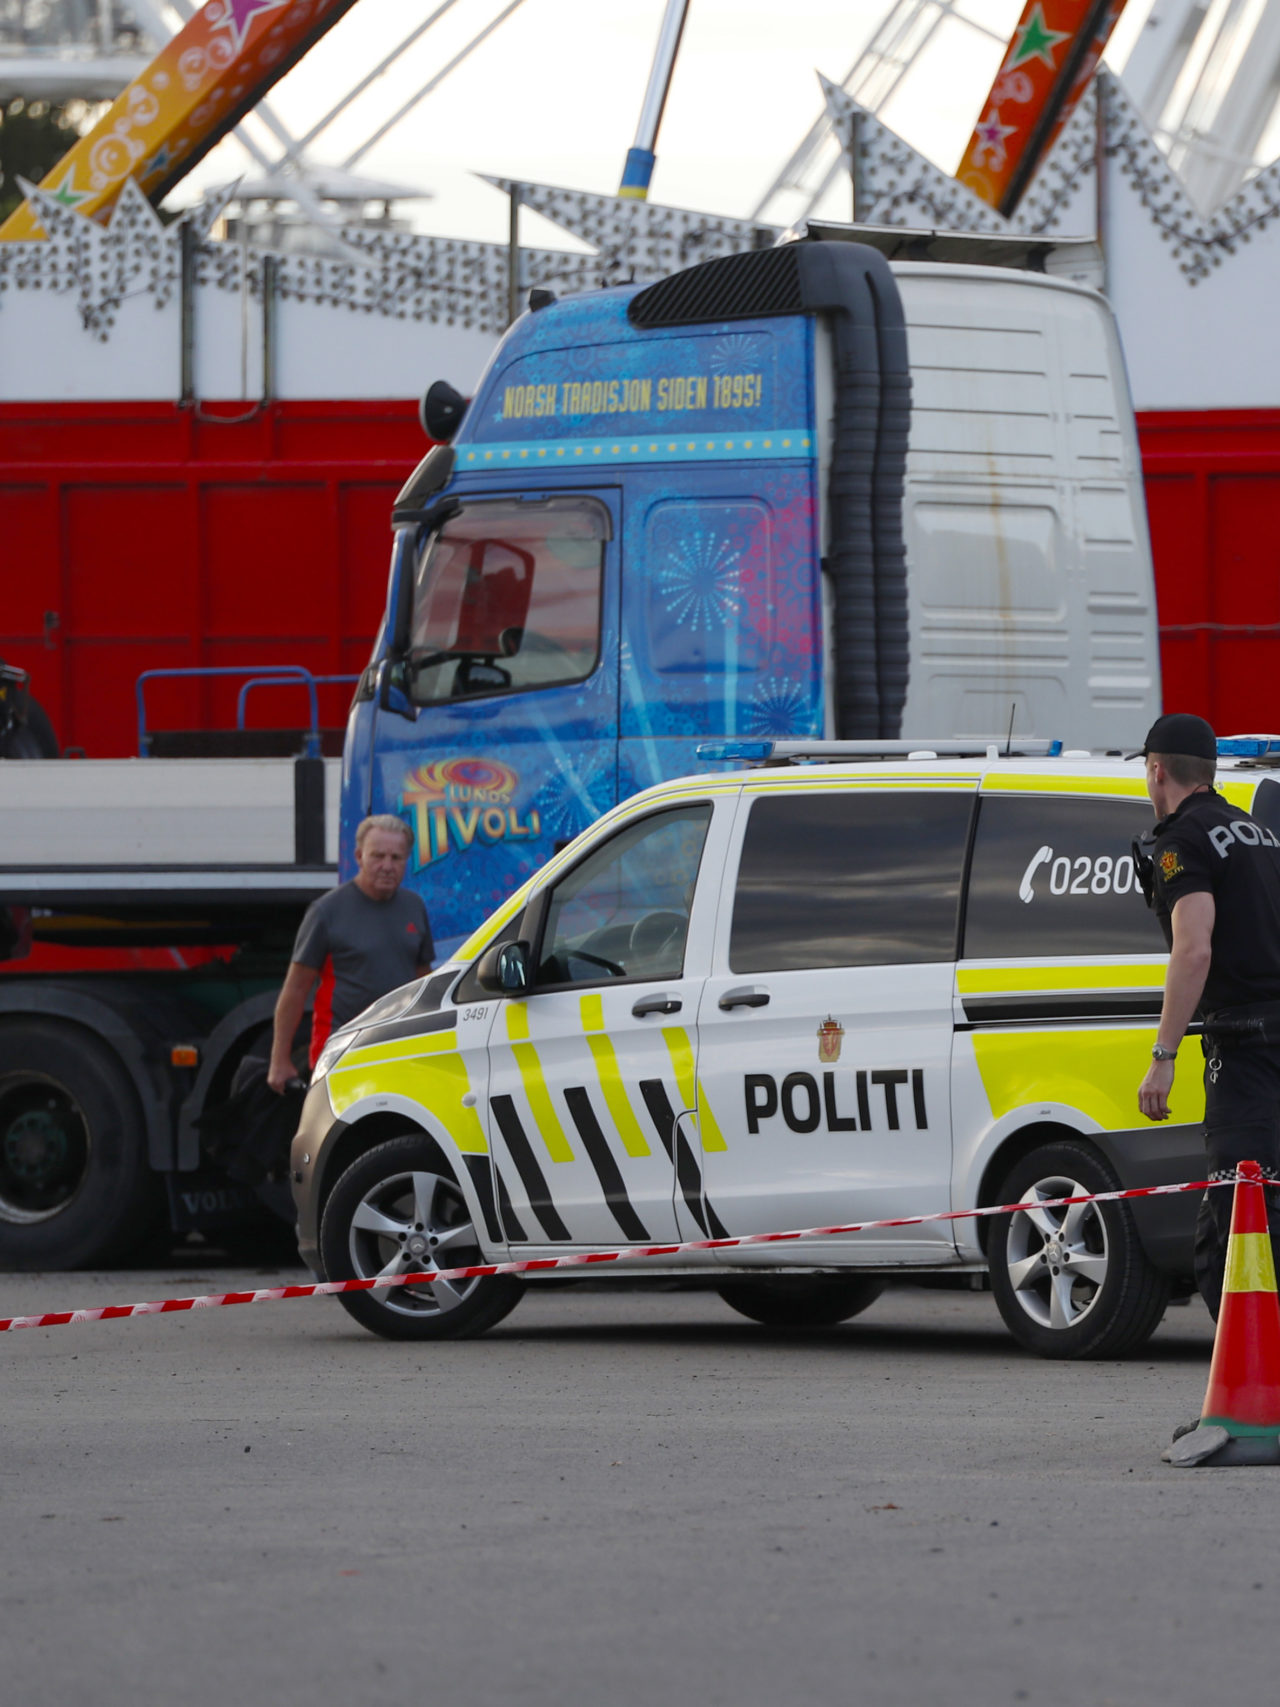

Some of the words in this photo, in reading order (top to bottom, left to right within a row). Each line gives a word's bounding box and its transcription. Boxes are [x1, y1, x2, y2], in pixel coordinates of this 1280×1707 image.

[562, 379, 652, 415] TRADISJON
[657, 377, 708, 410] SIDEN
[713, 374, 762, 408] 1895!
[400, 791, 541, 869] TIVOLI
[463, 1007, 489, 1021] 3491
[744, 1069, 928, 1134] POLITI
